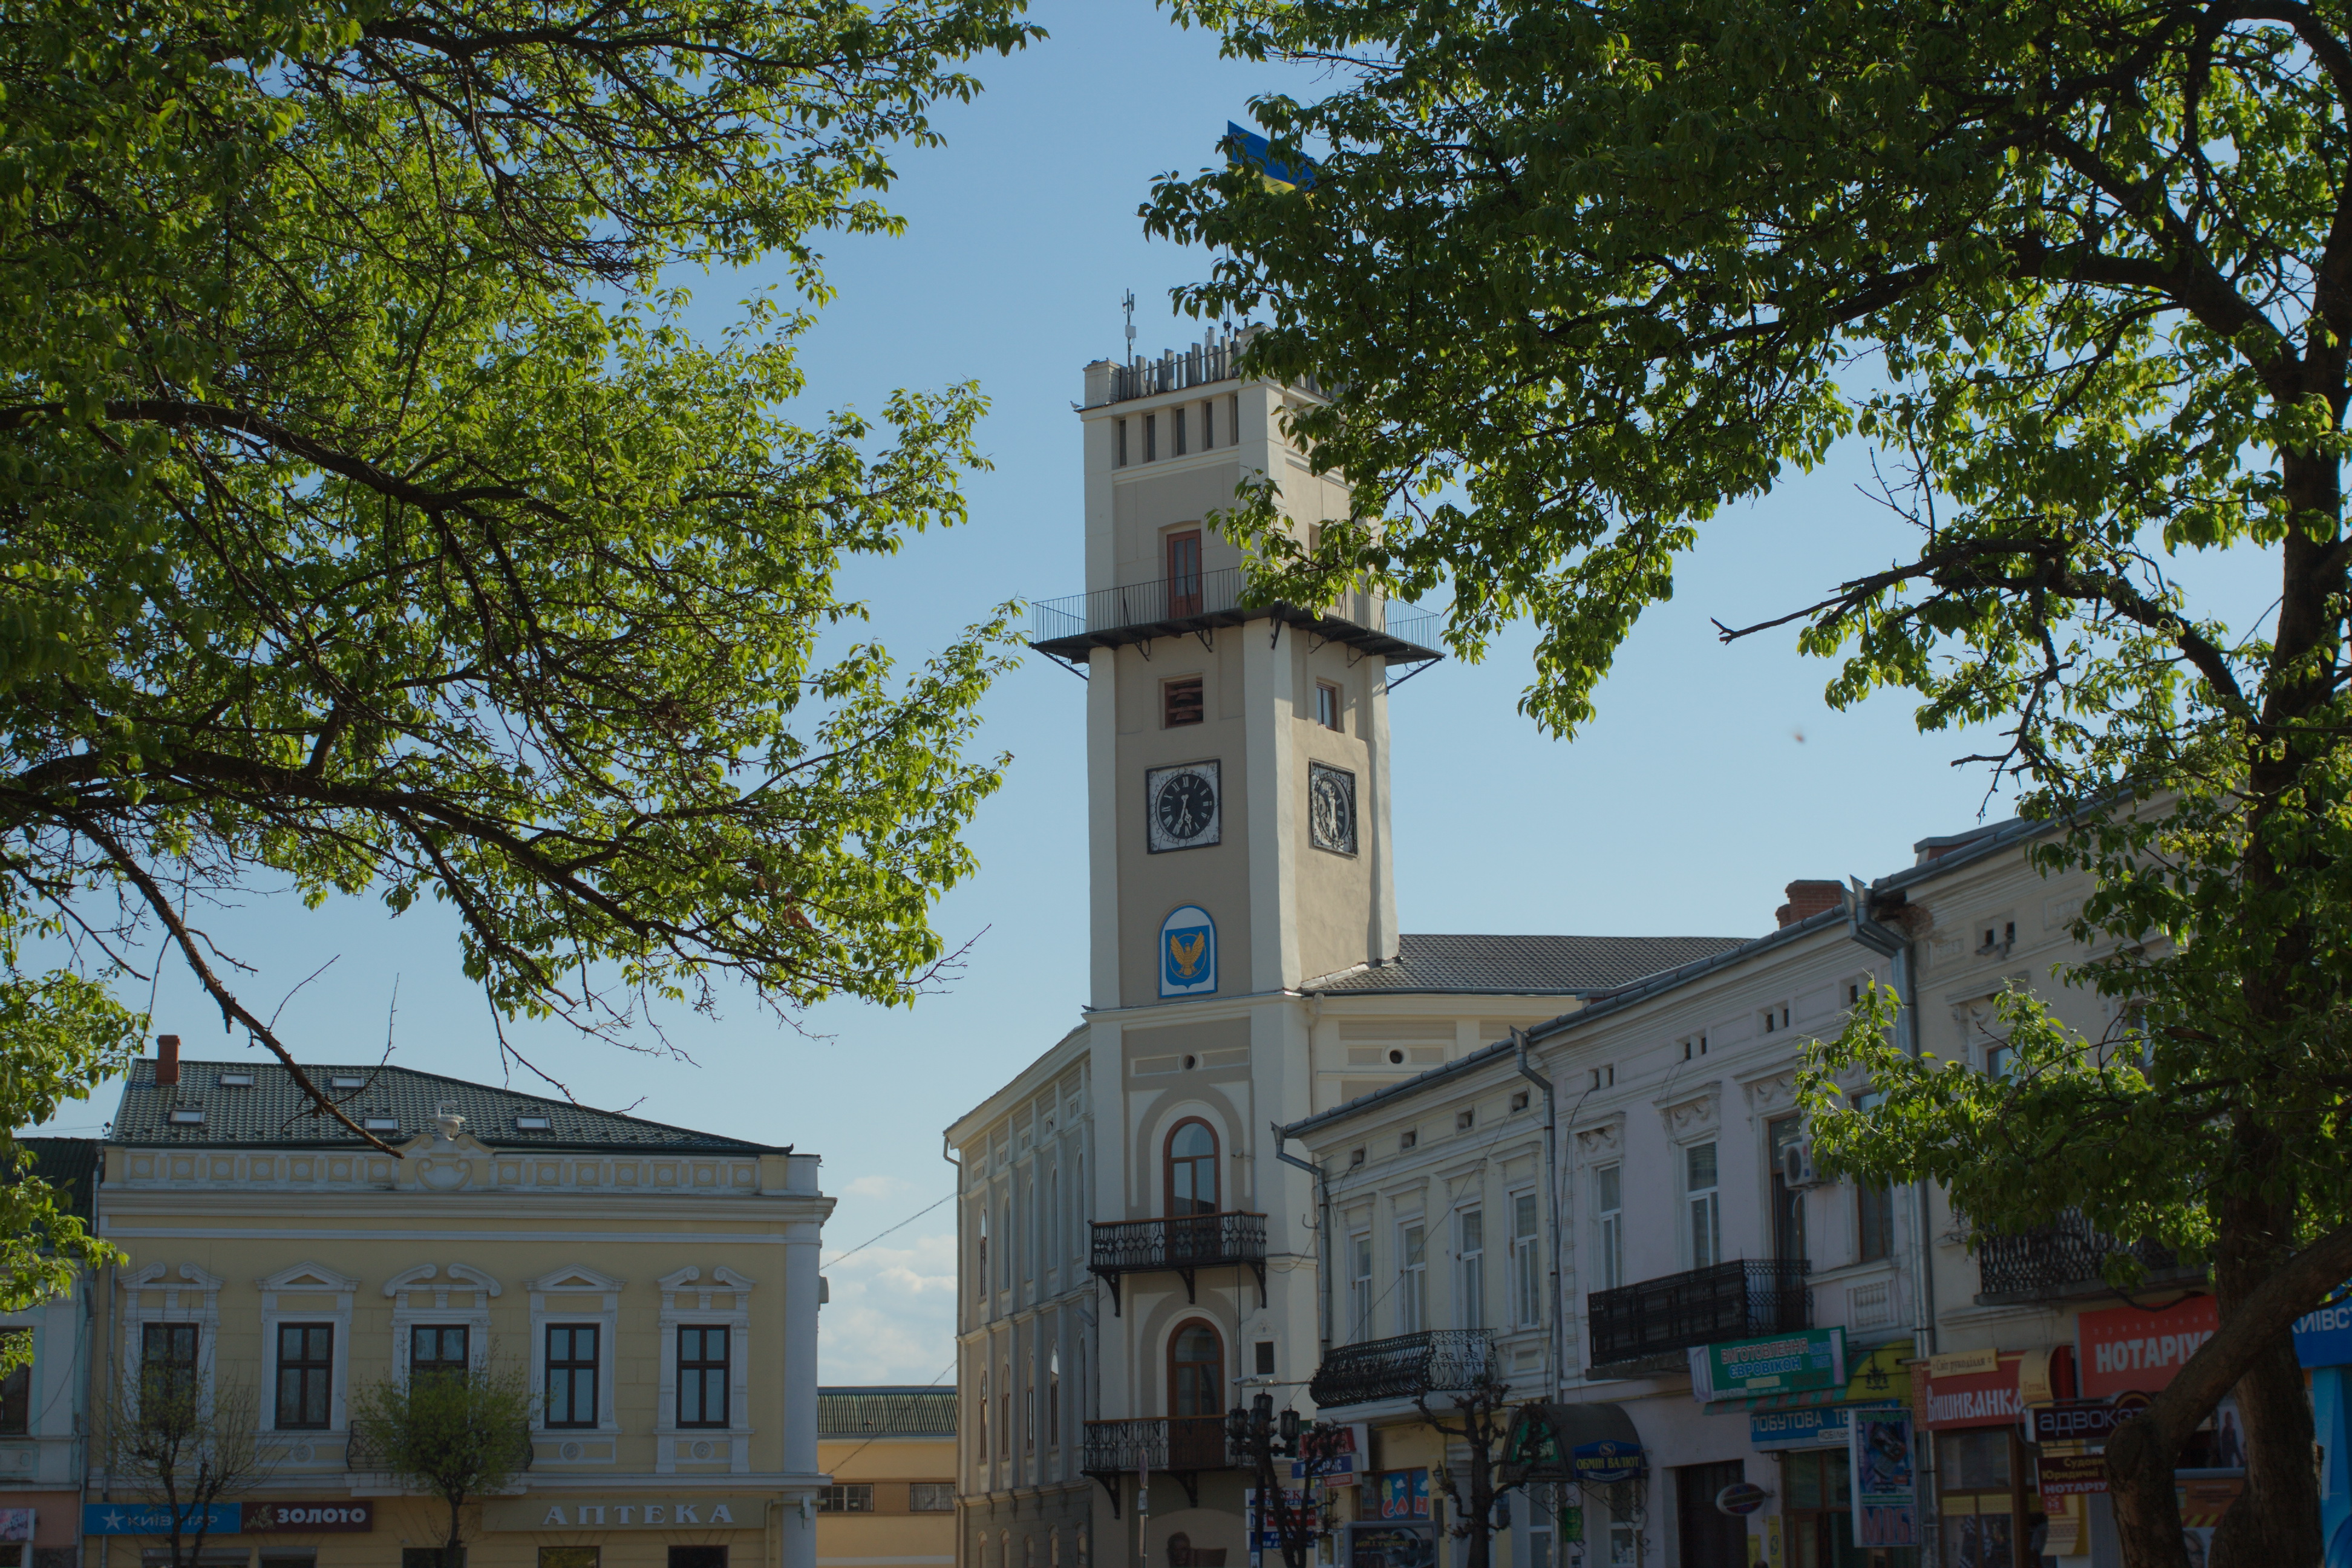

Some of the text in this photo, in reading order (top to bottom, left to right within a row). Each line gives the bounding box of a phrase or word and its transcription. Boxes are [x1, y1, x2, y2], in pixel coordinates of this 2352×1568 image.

[1720, 1337, 1809, 1364] ВИГОТОВЛЕННЯ
[1728, 1356, 1802, 1379] ЄВРОВІКОН
[1751, 1411, 1823, 1432] ПОБУТОВА
[1576, 1456, 1639, 1470] ОБМІН ВАЛЮТ
[2044, 1482, 2108, 1494] НОТАРІУ
[276, 1508, 367, 1524] ЗОЛОТО
[542, 1504, 734, 1525] АПТЕКА
